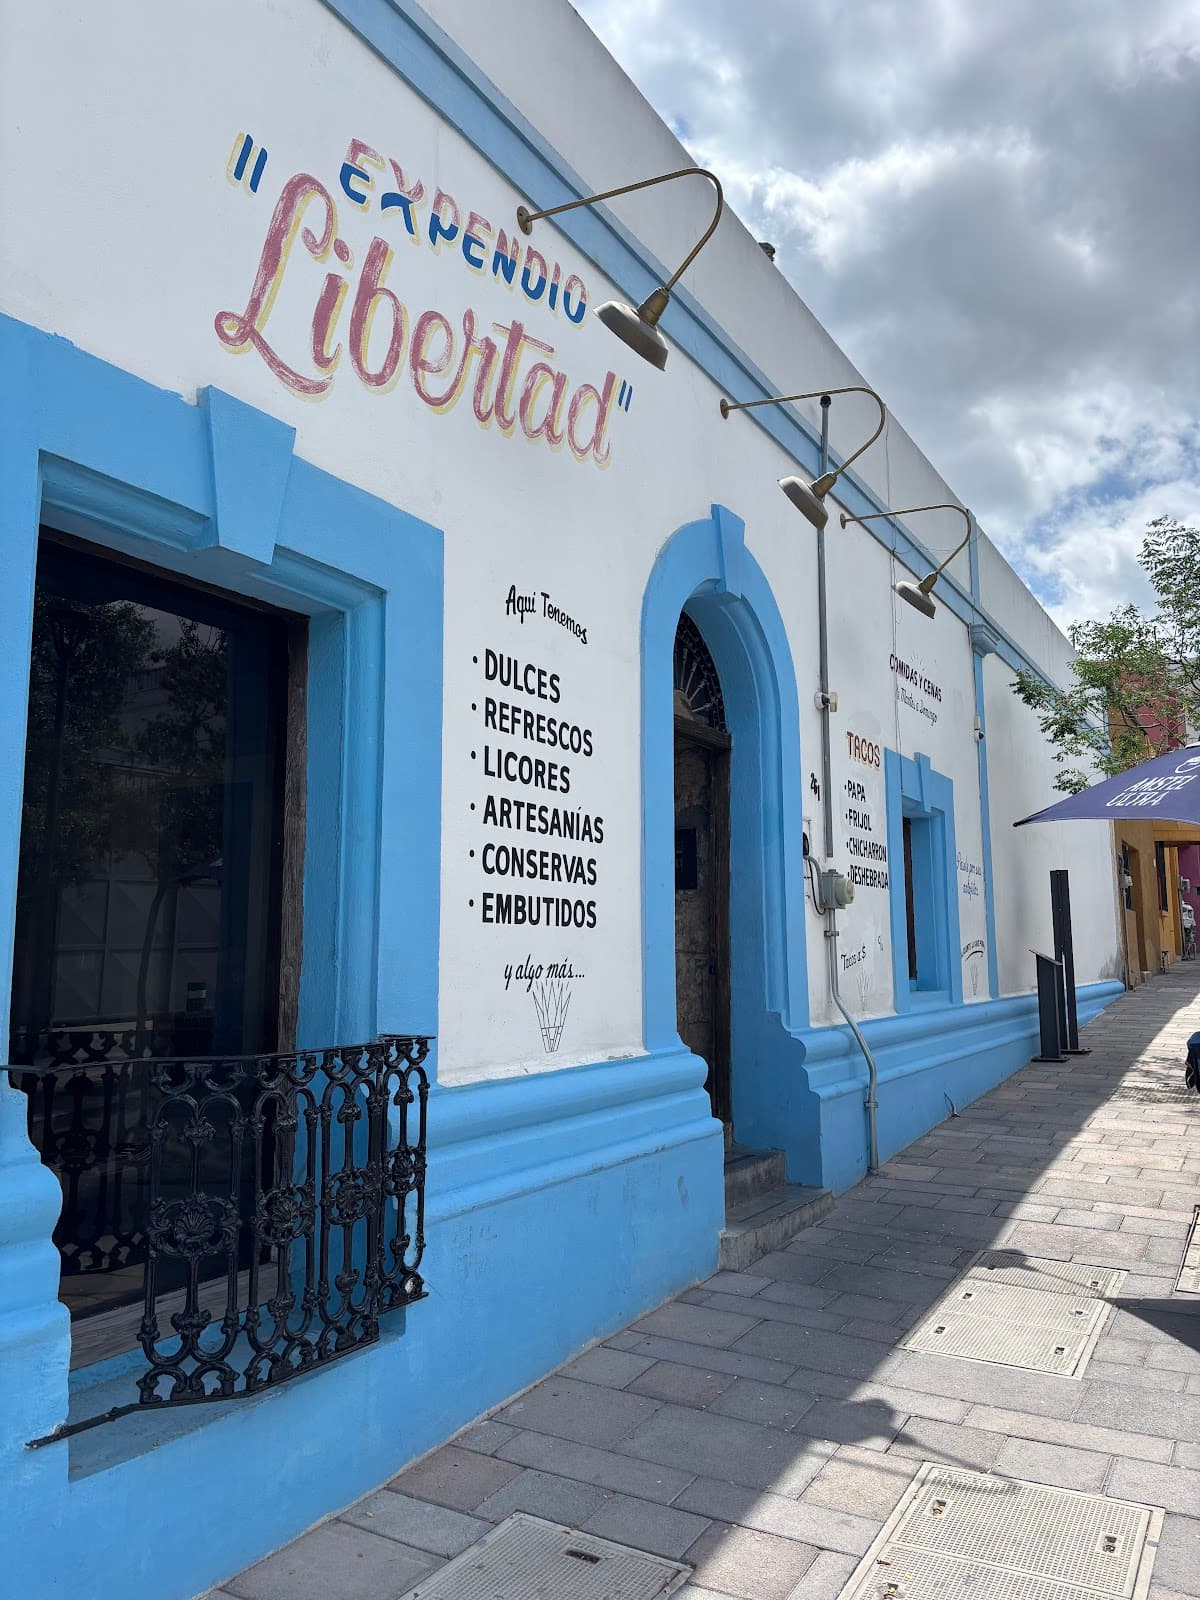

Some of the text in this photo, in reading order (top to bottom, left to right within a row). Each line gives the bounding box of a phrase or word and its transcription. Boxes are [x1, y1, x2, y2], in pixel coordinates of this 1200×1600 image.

[340, 138, 588, 323] EXPENDIO
[506, 584, 588, 645] Aqui Tenemos
[485, 648, 561, 704] DULCES
[889, 653, 918, 687] COMIDAS
[923, 678, 942, 702] CENAS
[484, 696, 593, 757] REFRESCOS
[483, 745, 570, 794] LICORES
[846, 731, 880, 770] TACOS
[847, 779, 866, 802] PAPA
[1105, 791, 1170, 807] ULTRA
[1123, 775, 1198, 792] AMSTEL
[483, 795, 604, 844] ARTESANÍAS
[848, 808, 872, 832] FRIJOL
[482, 843, 597, 886] CONSERVAS
[849, 837, 887, 863] CHICHARRON
[850, 865, 889, 889] DESHEBRADA
[482, 892, 597, 929] EMBUTIDOS
[504, 962, 513, 990] y
[515, 953, 544, 993] algo
